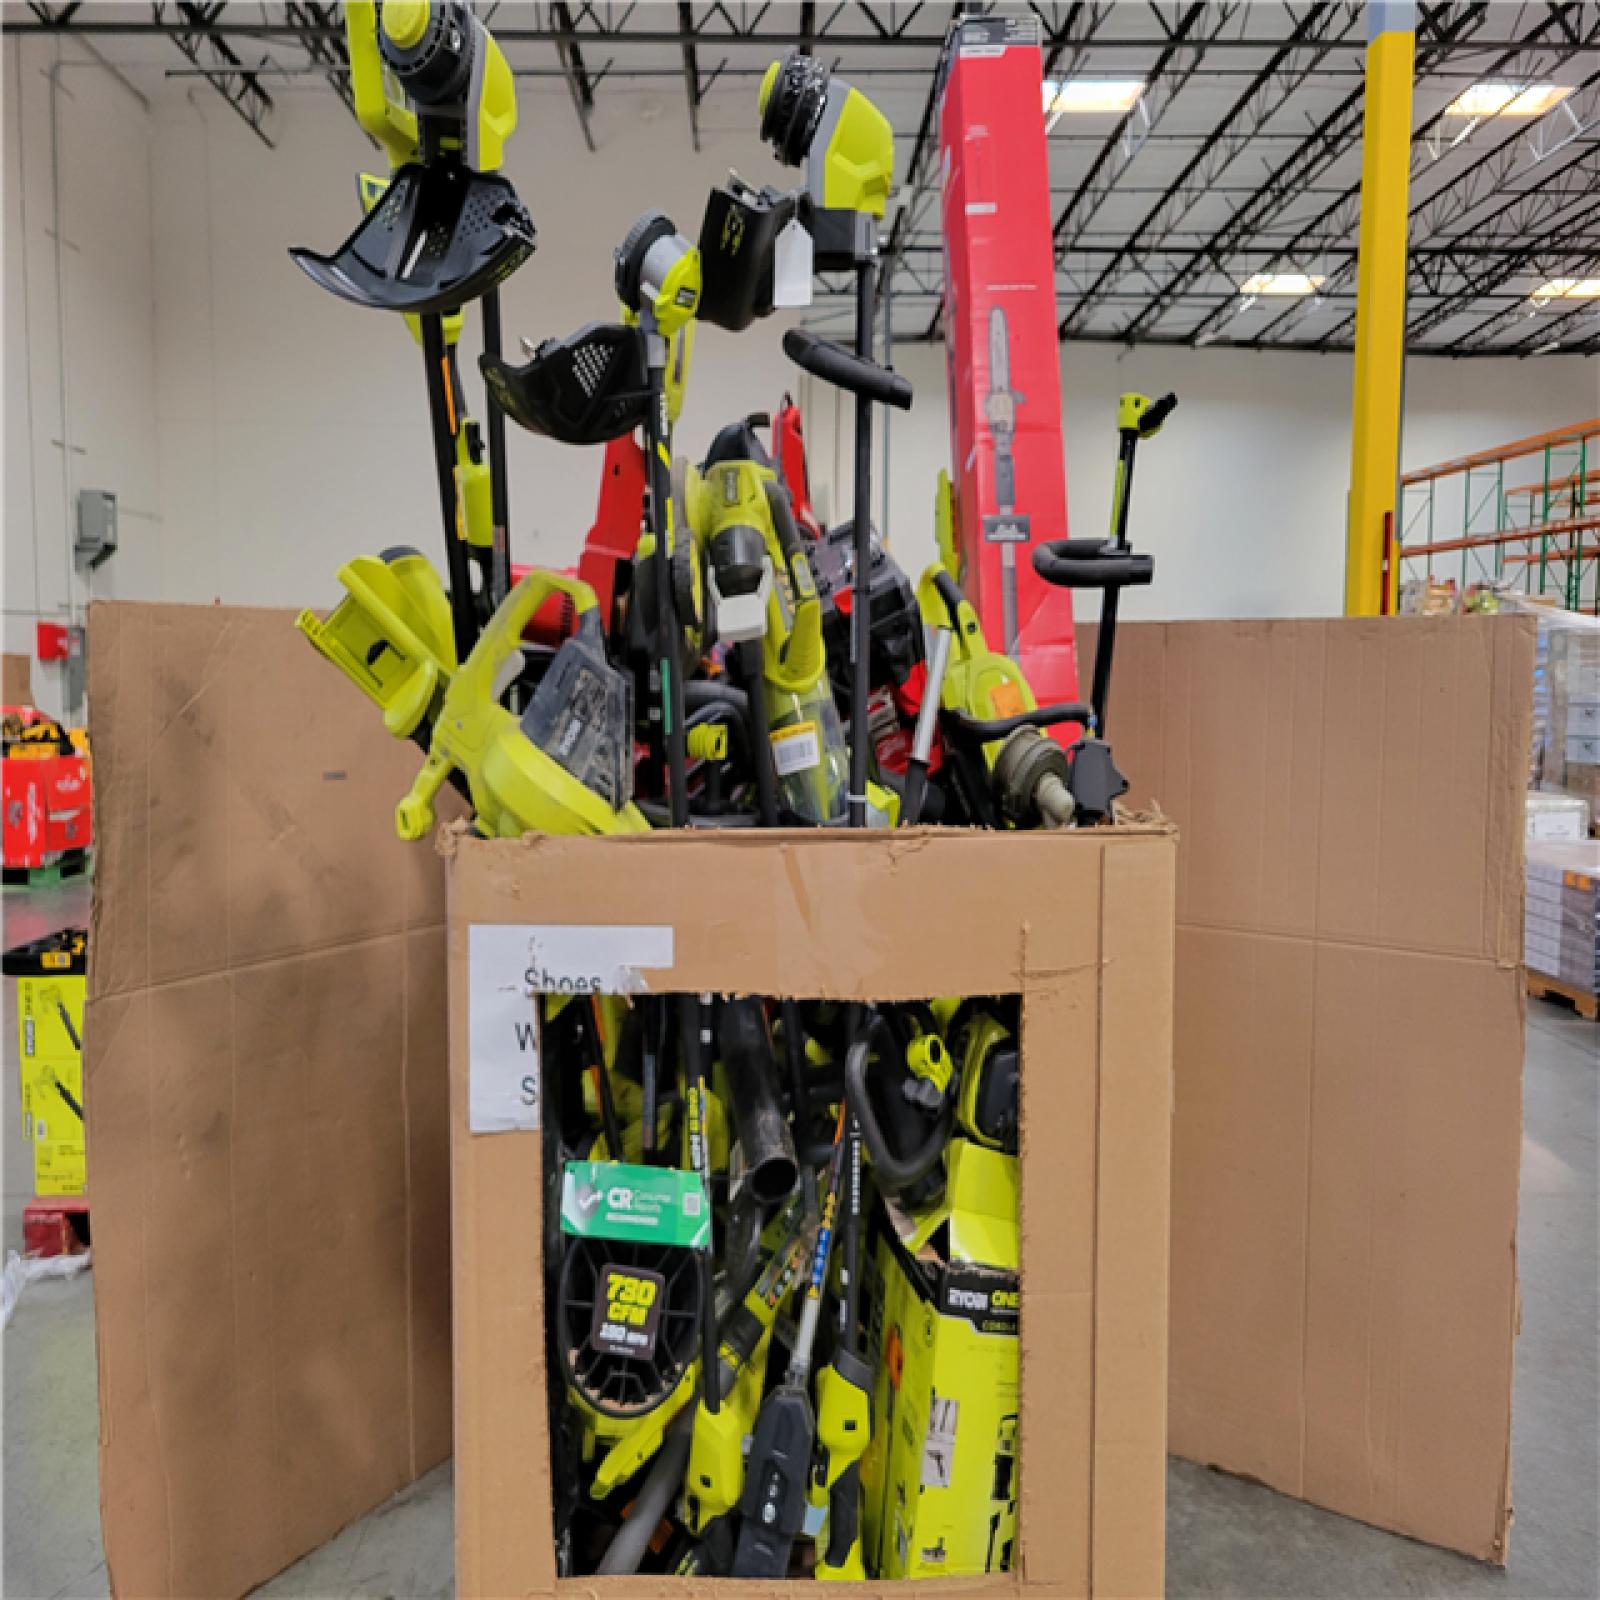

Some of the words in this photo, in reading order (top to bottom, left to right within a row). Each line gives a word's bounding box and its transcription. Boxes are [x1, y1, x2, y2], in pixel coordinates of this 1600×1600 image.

[524, 967, 603, 996] Shoes
[520, 1075, 536, 1105] S
[607, 1187, 632, 1210] CR
